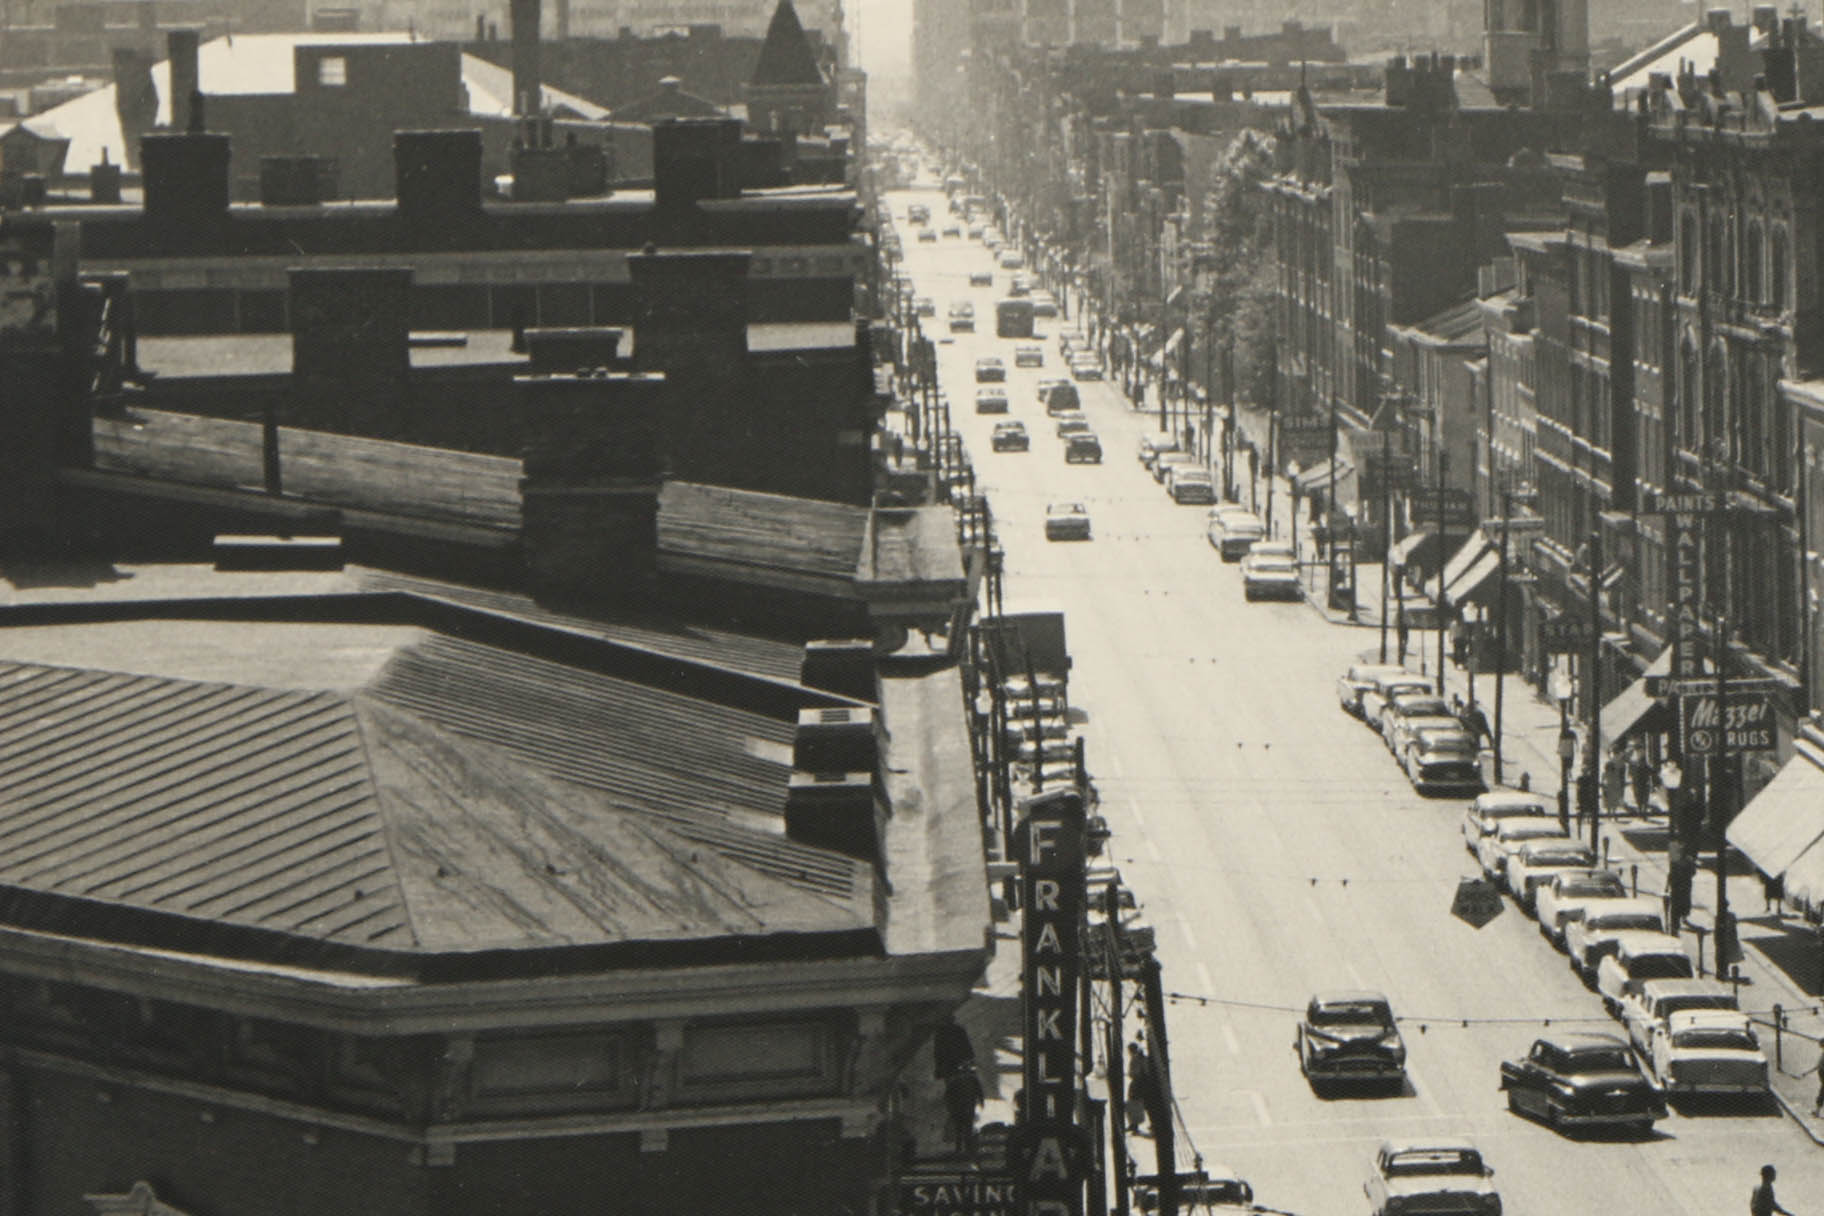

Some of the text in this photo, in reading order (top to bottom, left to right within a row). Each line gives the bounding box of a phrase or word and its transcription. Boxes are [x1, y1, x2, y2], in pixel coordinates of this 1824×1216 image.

[1655, 495, 1716, 511] PAINTS
[1676, 513, 1694, 676] WALLPAPER
[1714, 730, 1770, 747] RUGS
